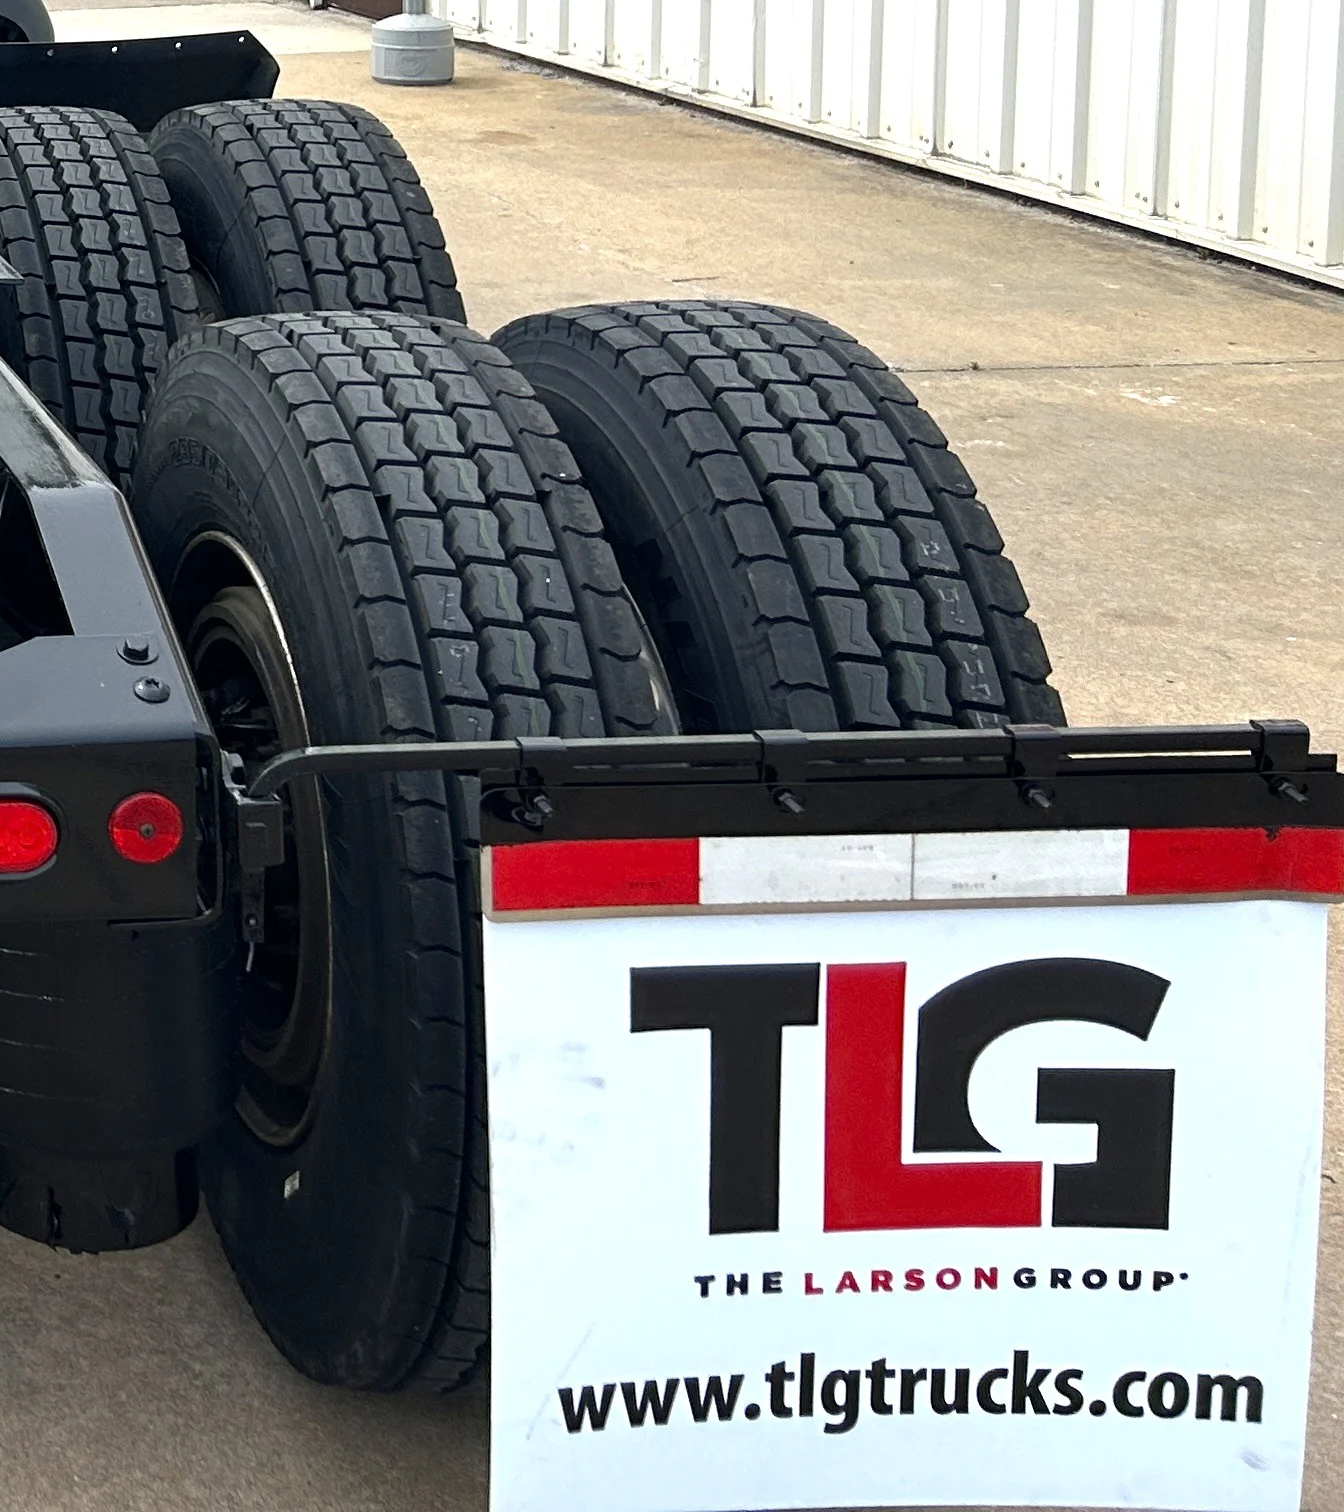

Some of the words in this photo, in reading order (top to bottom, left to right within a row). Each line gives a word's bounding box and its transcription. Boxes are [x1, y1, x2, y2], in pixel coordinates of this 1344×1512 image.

[630, 956, 1176, 1235] TLG
[694, 1270, 784, 1298] THE
[558, 1350, 1265, 1435] www.tlgtrucks.com
